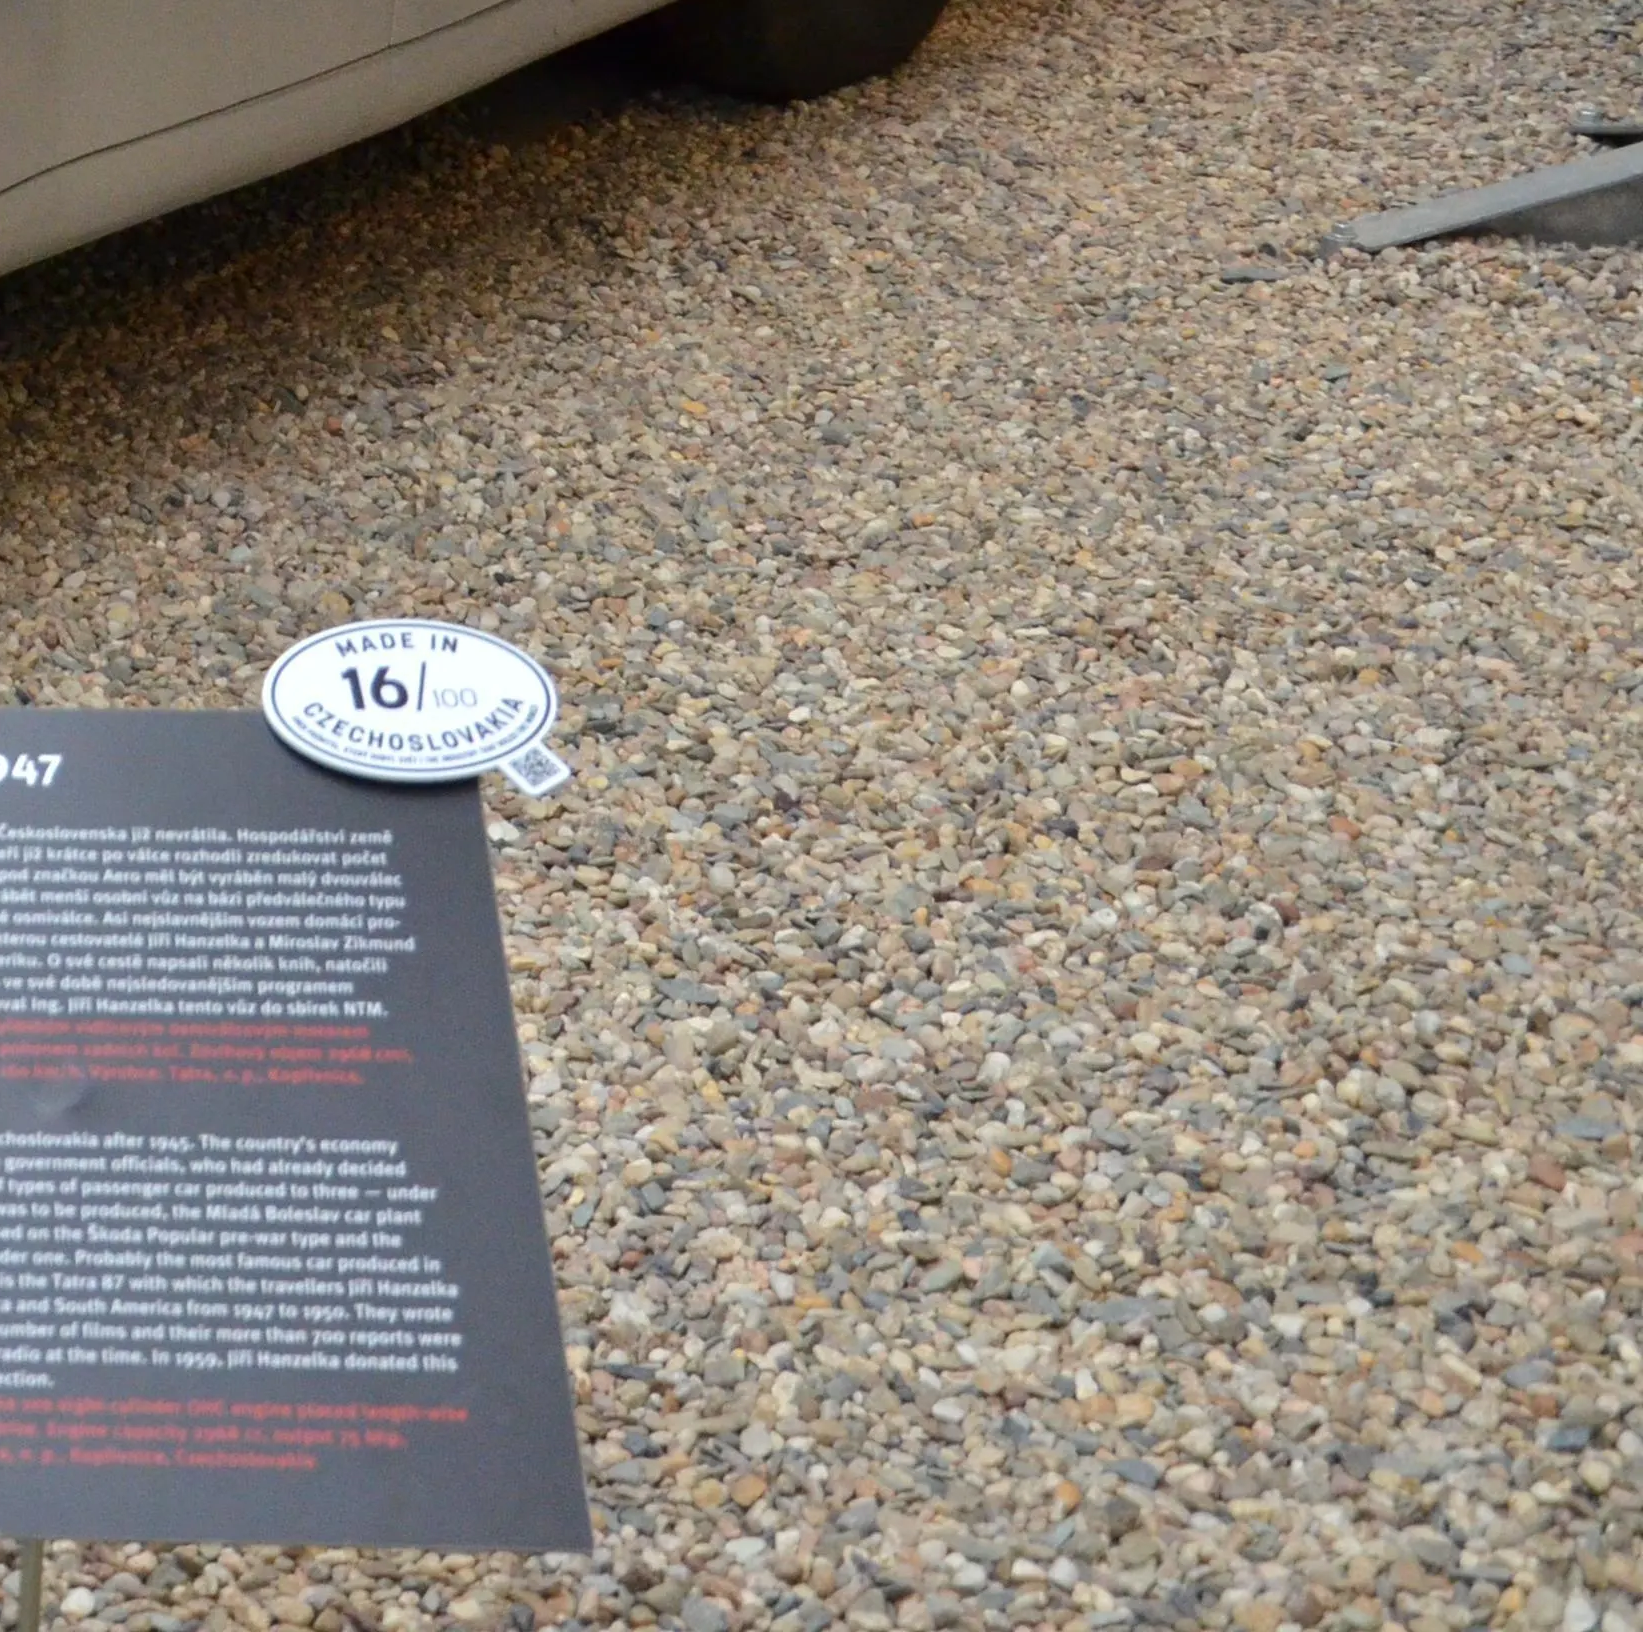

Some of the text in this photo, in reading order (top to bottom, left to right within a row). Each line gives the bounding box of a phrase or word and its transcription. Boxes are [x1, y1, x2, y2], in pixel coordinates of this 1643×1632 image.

[335, 631, 460, 658] MADE IN
[302, 696, 525, 752] CZECHOSLOVAKIA
